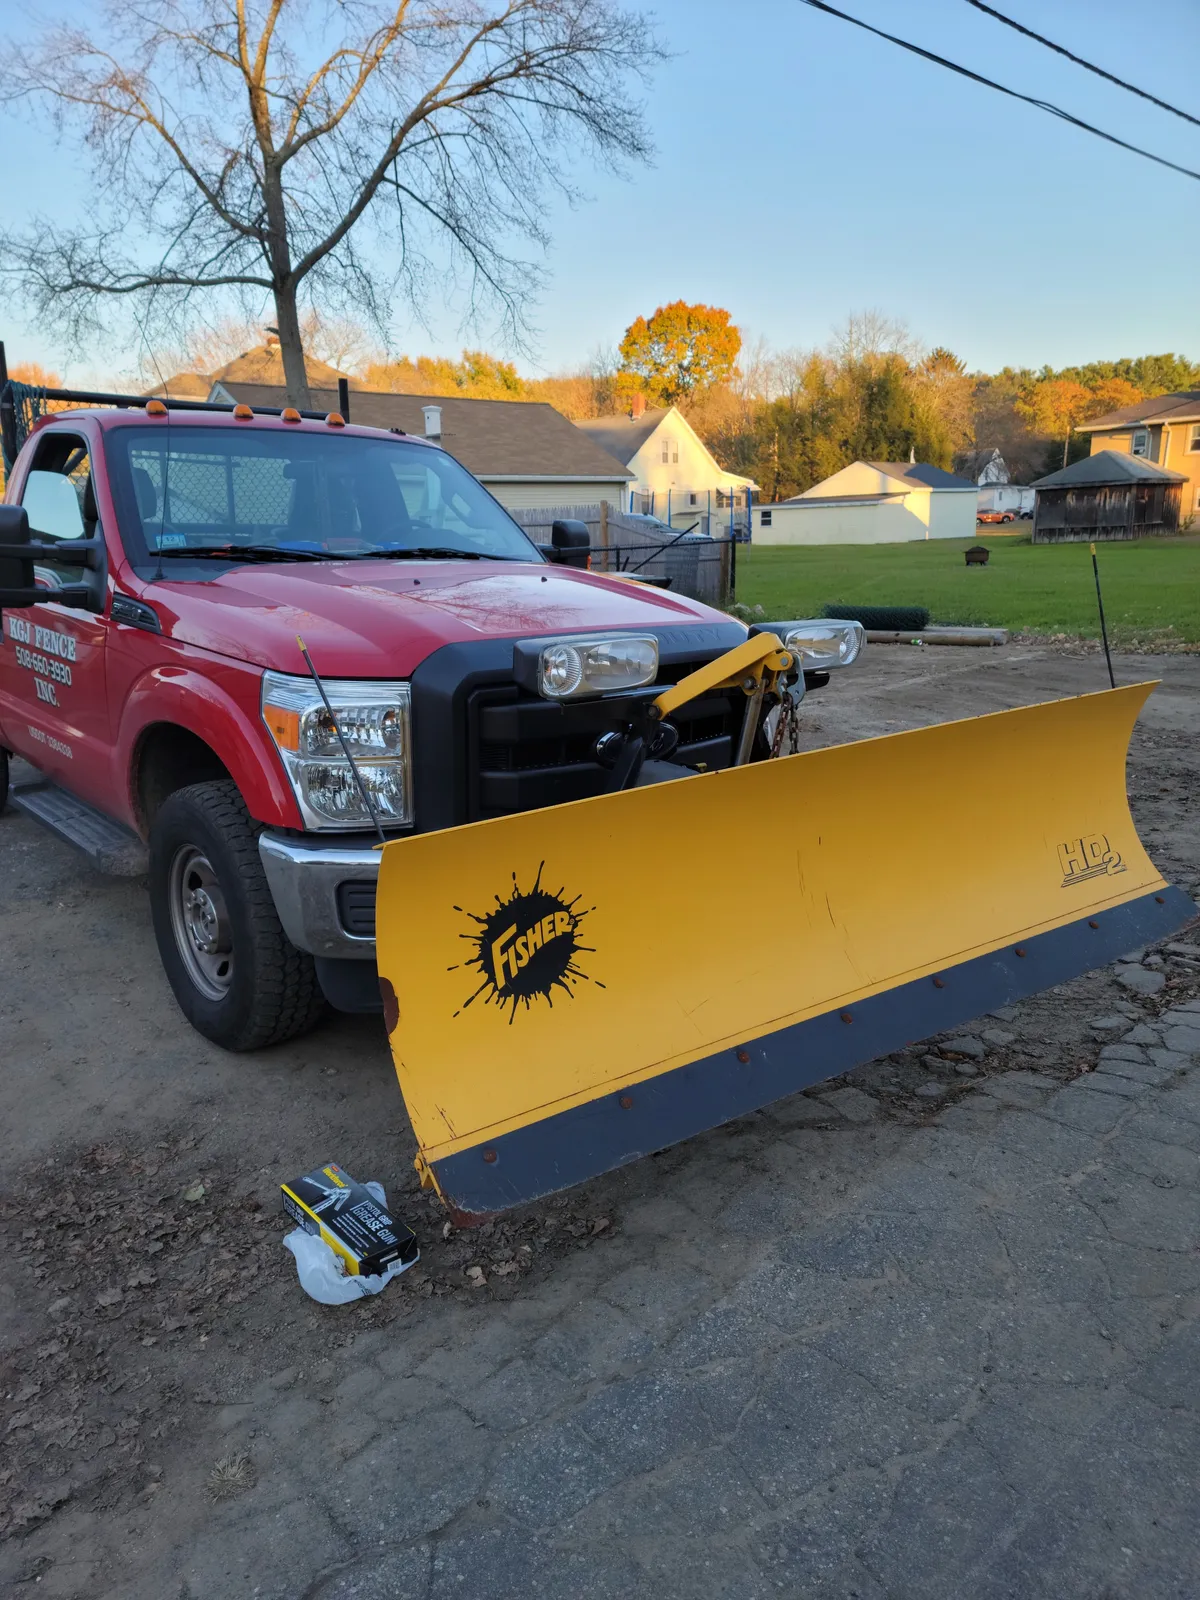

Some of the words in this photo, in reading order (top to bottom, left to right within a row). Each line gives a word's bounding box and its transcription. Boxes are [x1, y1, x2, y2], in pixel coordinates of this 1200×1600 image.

[8, 617, 31, 645] KGJ
[34, 626, 77, 661] FENCE
[15, 646, 72, 686] 508-660-3930
[33, 677, 61, 707] INC.
[27, 724, 46, 744] USDOT
[491, 910, 573, 991] FISHER
[352, 1207, 384, 1232] GREASE
[376, 1228, 398, 1245] GUN
[363, 1201, 382, 1218] PISTOL
[378, 1214, 393, 1225] GRIP
